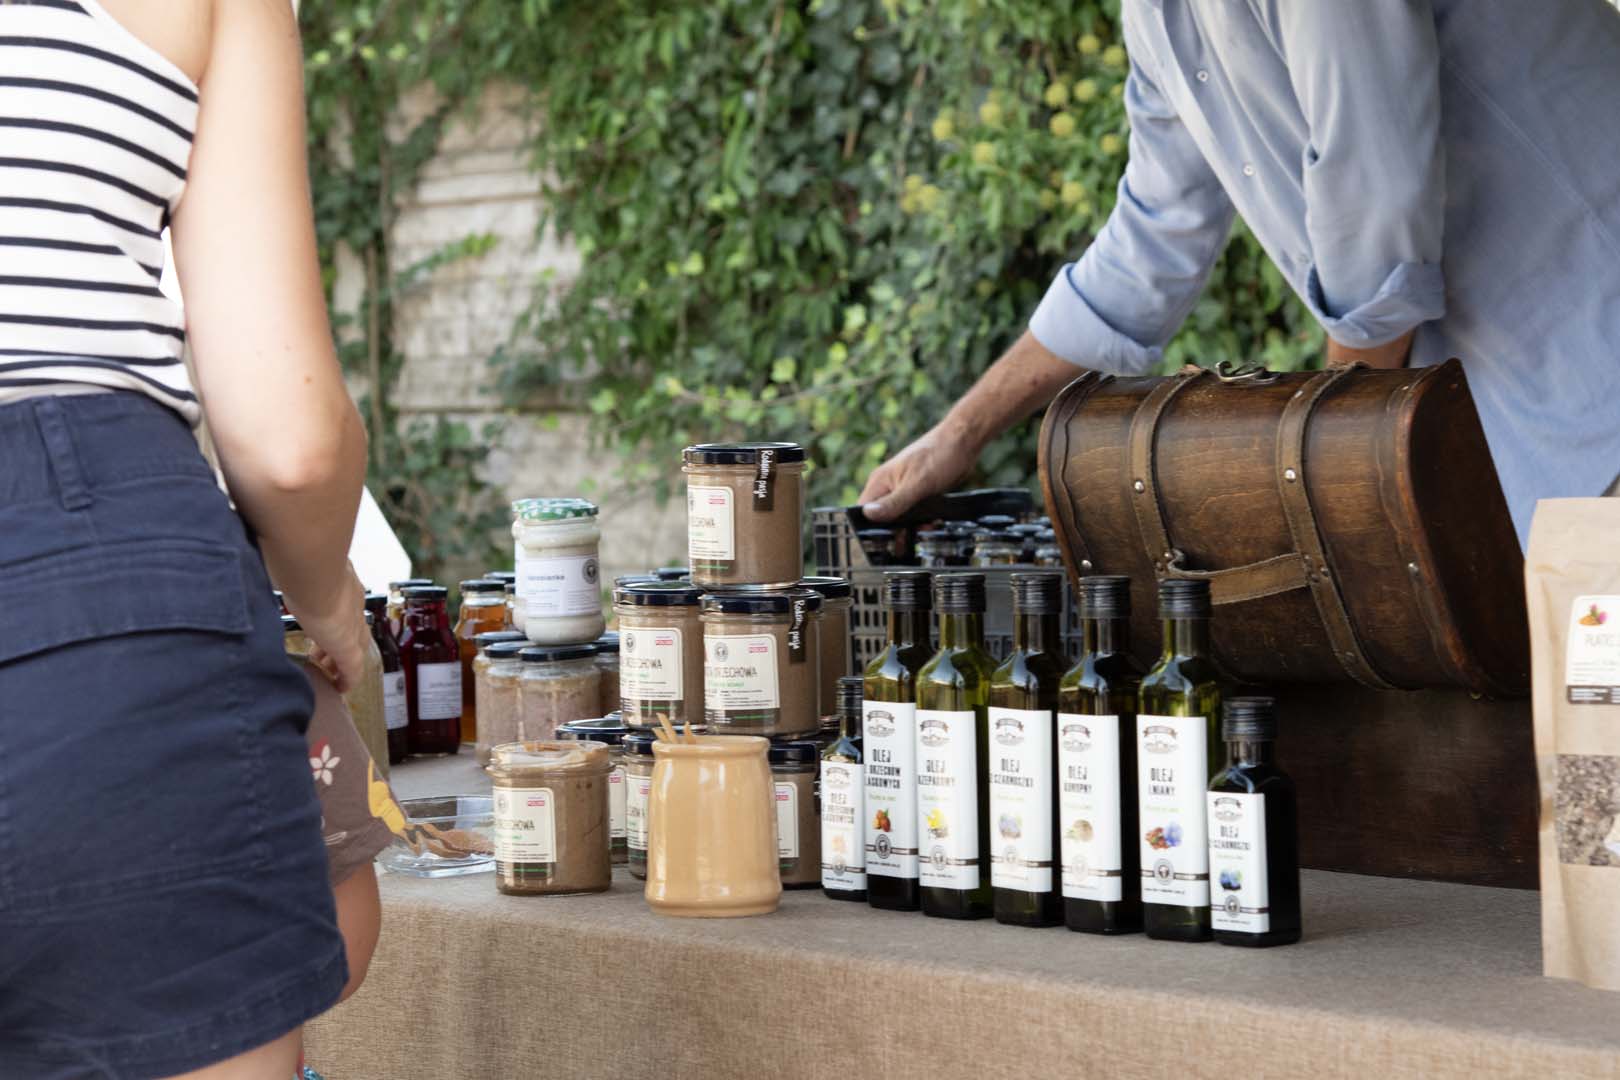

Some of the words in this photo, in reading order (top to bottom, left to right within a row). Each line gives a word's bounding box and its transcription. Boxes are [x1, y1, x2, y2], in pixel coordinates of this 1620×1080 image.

[753, 480, 767, 499] pasja
[788, 631, 800, 650] pasja
[872, 748, 891, 763] OLEJ
[926, 759, 945, 773] OLEJ
[1001, 758, 1020, 773] OLEJ
[1068, 765, 1087, 780] OLEJ
[1150, 767, 1173, 782] OLEJ
[831, 792, 847, 804] OLEJ
[1220, 825, 1239, 838] OLEJ
